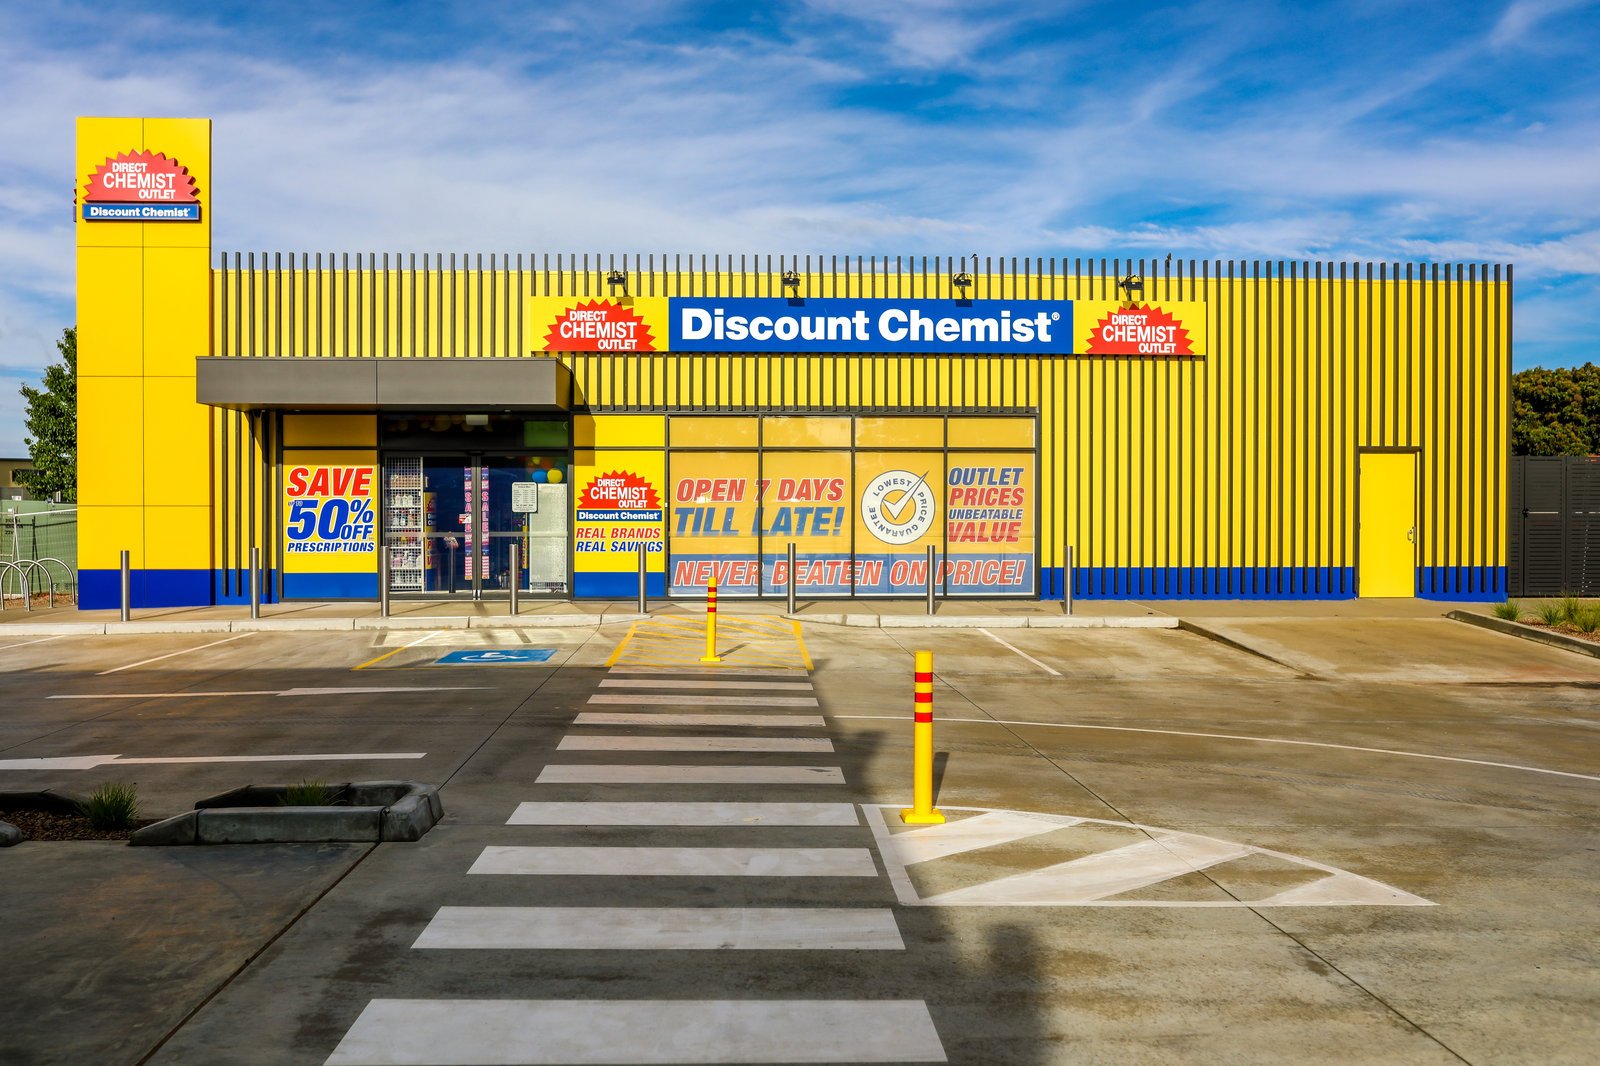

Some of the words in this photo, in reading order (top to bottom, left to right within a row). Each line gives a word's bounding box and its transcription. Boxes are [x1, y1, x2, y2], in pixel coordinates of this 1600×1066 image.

[112, 163, 147, 172] DIRECT
[103, 173, 176, 188] CHEMIST
[139, 190, 176, 199] OUTLET
[90, 207, 140, 216] Discount
[569, 311, 607, 322] DIRECT
[1111, 314, 1148, 325] DIRECT
[560, 322, 637, 339] CHEMIST
[682, 308, 870, 341] Discount
[1102, 326, 1176, 343] CHEMIST
[598, 339, 637, 350] OUTLET
[1138, 343, 1176, 354] OUTLET
[286, 466, 374, 497] SAVE
[597, 479, 625, 487] DIRECT
[948, 467, 1024, 486] OUTLET
[590, 487, 648, 500] CHEMIST
[676, 478, 747, 503] OPEN
[754, 478, 772, 503] 7
[777, 478, 846, 503] DAYS
[873, 478, 912, 496] LOWEST
[618, 500, 648, 508] OUTLET
[948, 487, 1025, 507] PRICES
[917, 491, 927, 523] PRICE
[948, 508, 1023, 520] UNBEATABLE
[287, 498, 374, 540] 50%
[579, 512, 619, 520] Discount
[674, 507, 739, 537] TILL
[751, 506, 846, 536] LATE!
[869, 507, 919, 537] GUARANTEE
[340, 524, 374, 540] OFF
[576, 527, 606, 539] REAL
[611, 527, 661, 539] BRANDS
[947, 521, 1022, 543] VALUE
[287, 542, 375, 553] PRESCRIPTIONS
[575, 541, 606, 552] REAL
[610, 541, 663, 552] SAVIGS
[673, 560, 764, 586] NEVER
[771, 560, 883, 586] BEATEN
[889, 560, 928, 586] ON
[935, 560, 1026, 586] PRICE!
